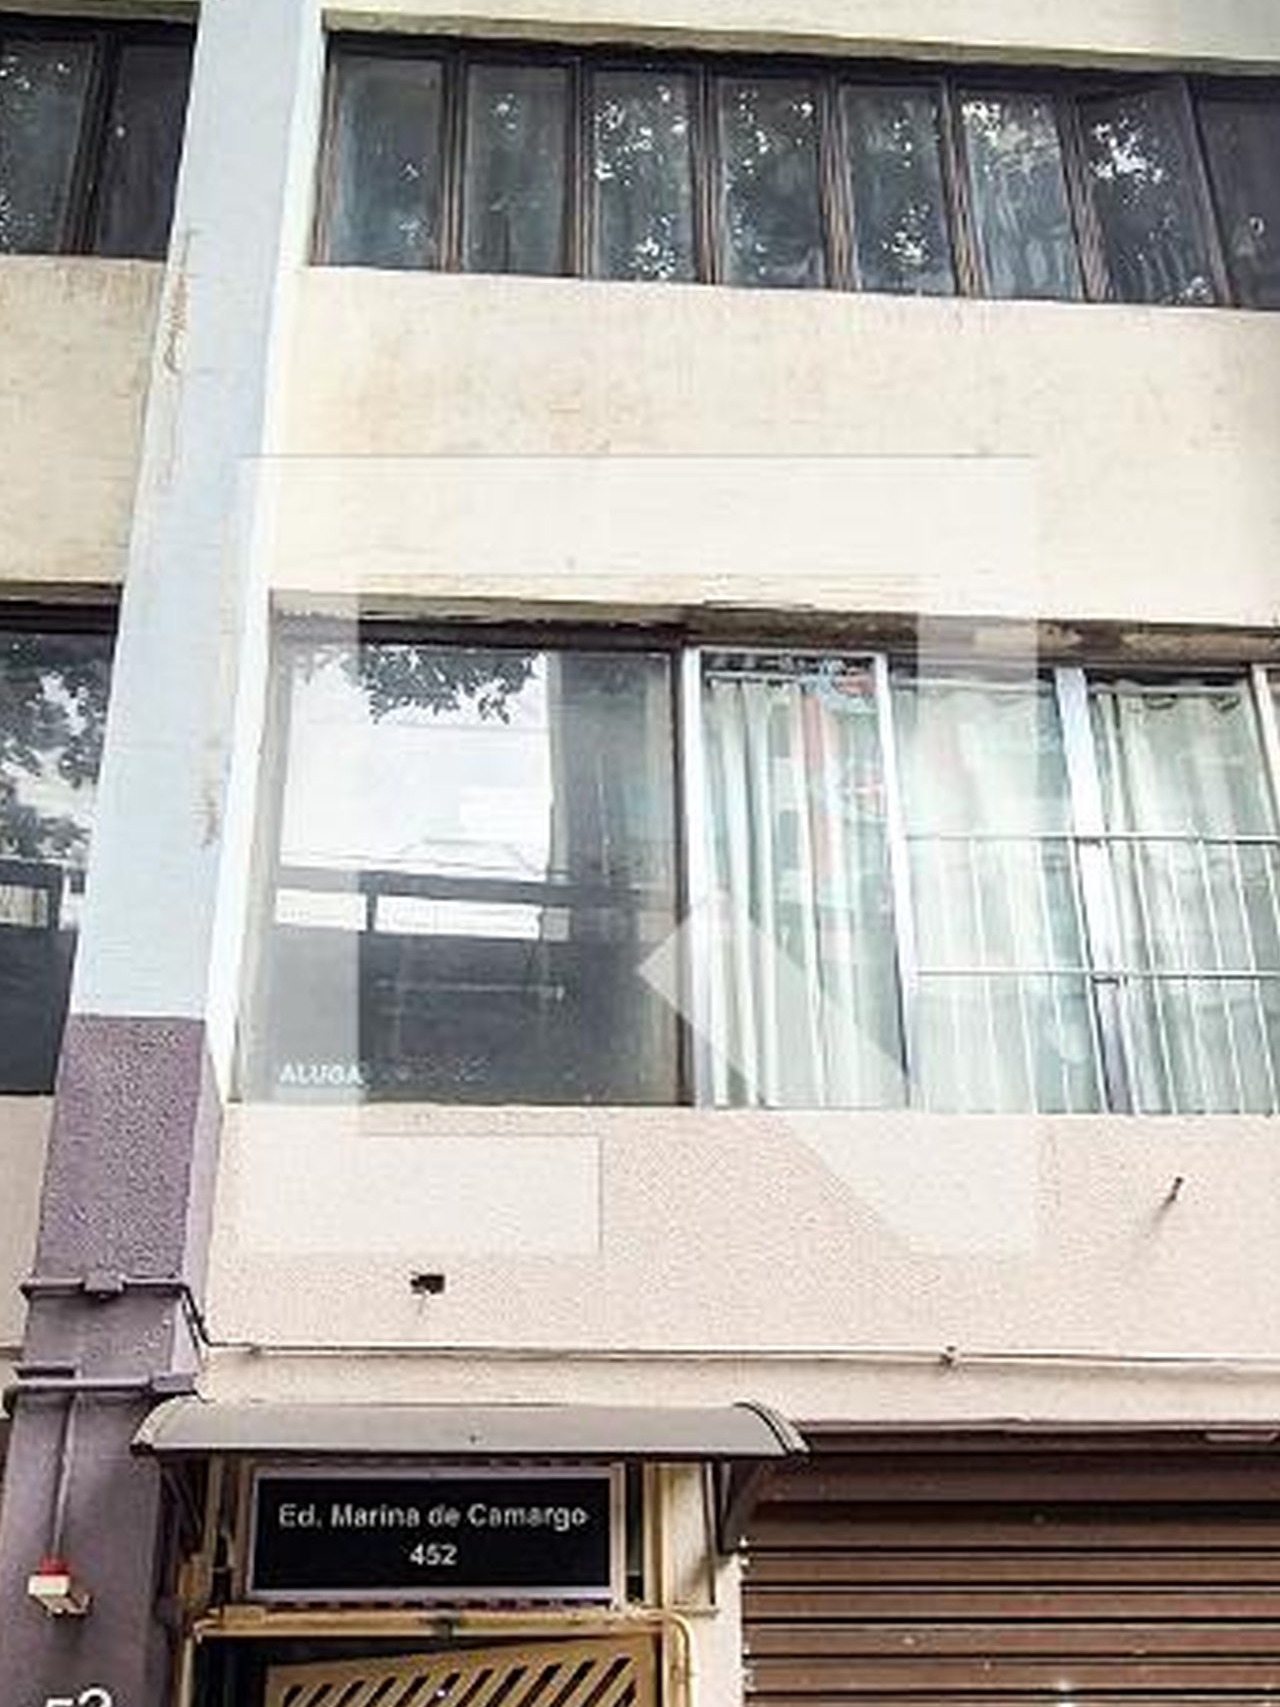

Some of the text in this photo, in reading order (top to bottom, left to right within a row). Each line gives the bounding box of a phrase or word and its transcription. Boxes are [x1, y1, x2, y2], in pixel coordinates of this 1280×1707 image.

[278, 1502, 588, 1533] Ed. Marina de Camargo
[409, 1543, 458, 1567] 452
